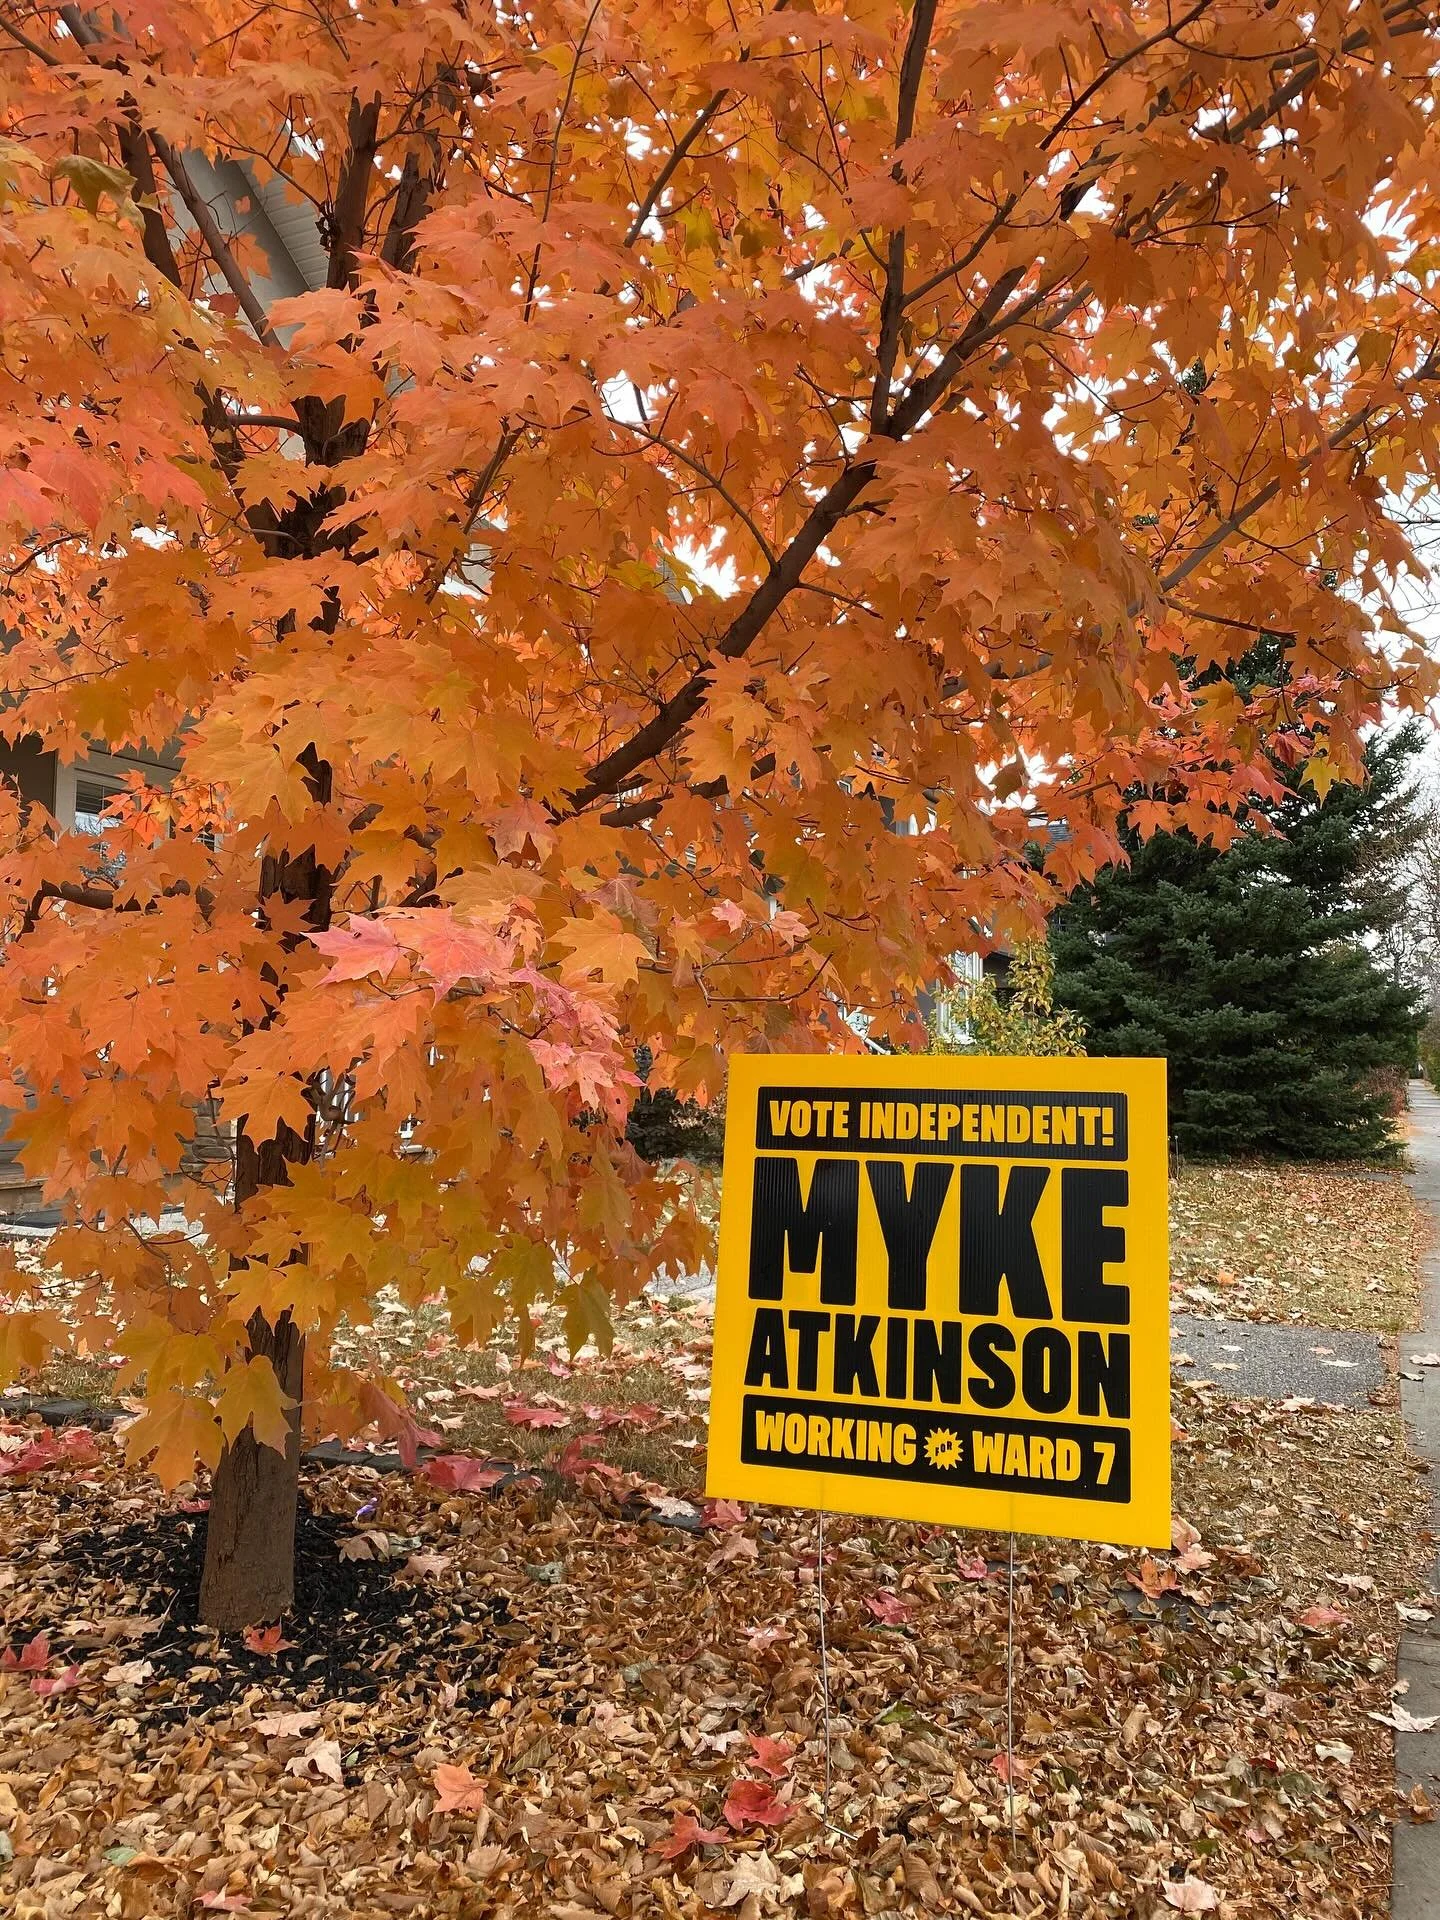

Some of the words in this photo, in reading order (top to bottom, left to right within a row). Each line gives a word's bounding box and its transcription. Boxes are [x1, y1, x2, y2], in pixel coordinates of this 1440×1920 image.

[769, 1100, 849, 1138] VOTE
[860, 1102, 1114, 1147] INDEPENDENT!
[748, 1156, 1130, 1326] MYKE
[744, 1307, 1131, 1420] ATKINSON
[755, 1410, 917, 1466] WORKING
[934, 1439, 953, 1457] FOR
[972, 1430, 1082, 1482] WARD
[1094, 1442, 1116, 1486] 7
